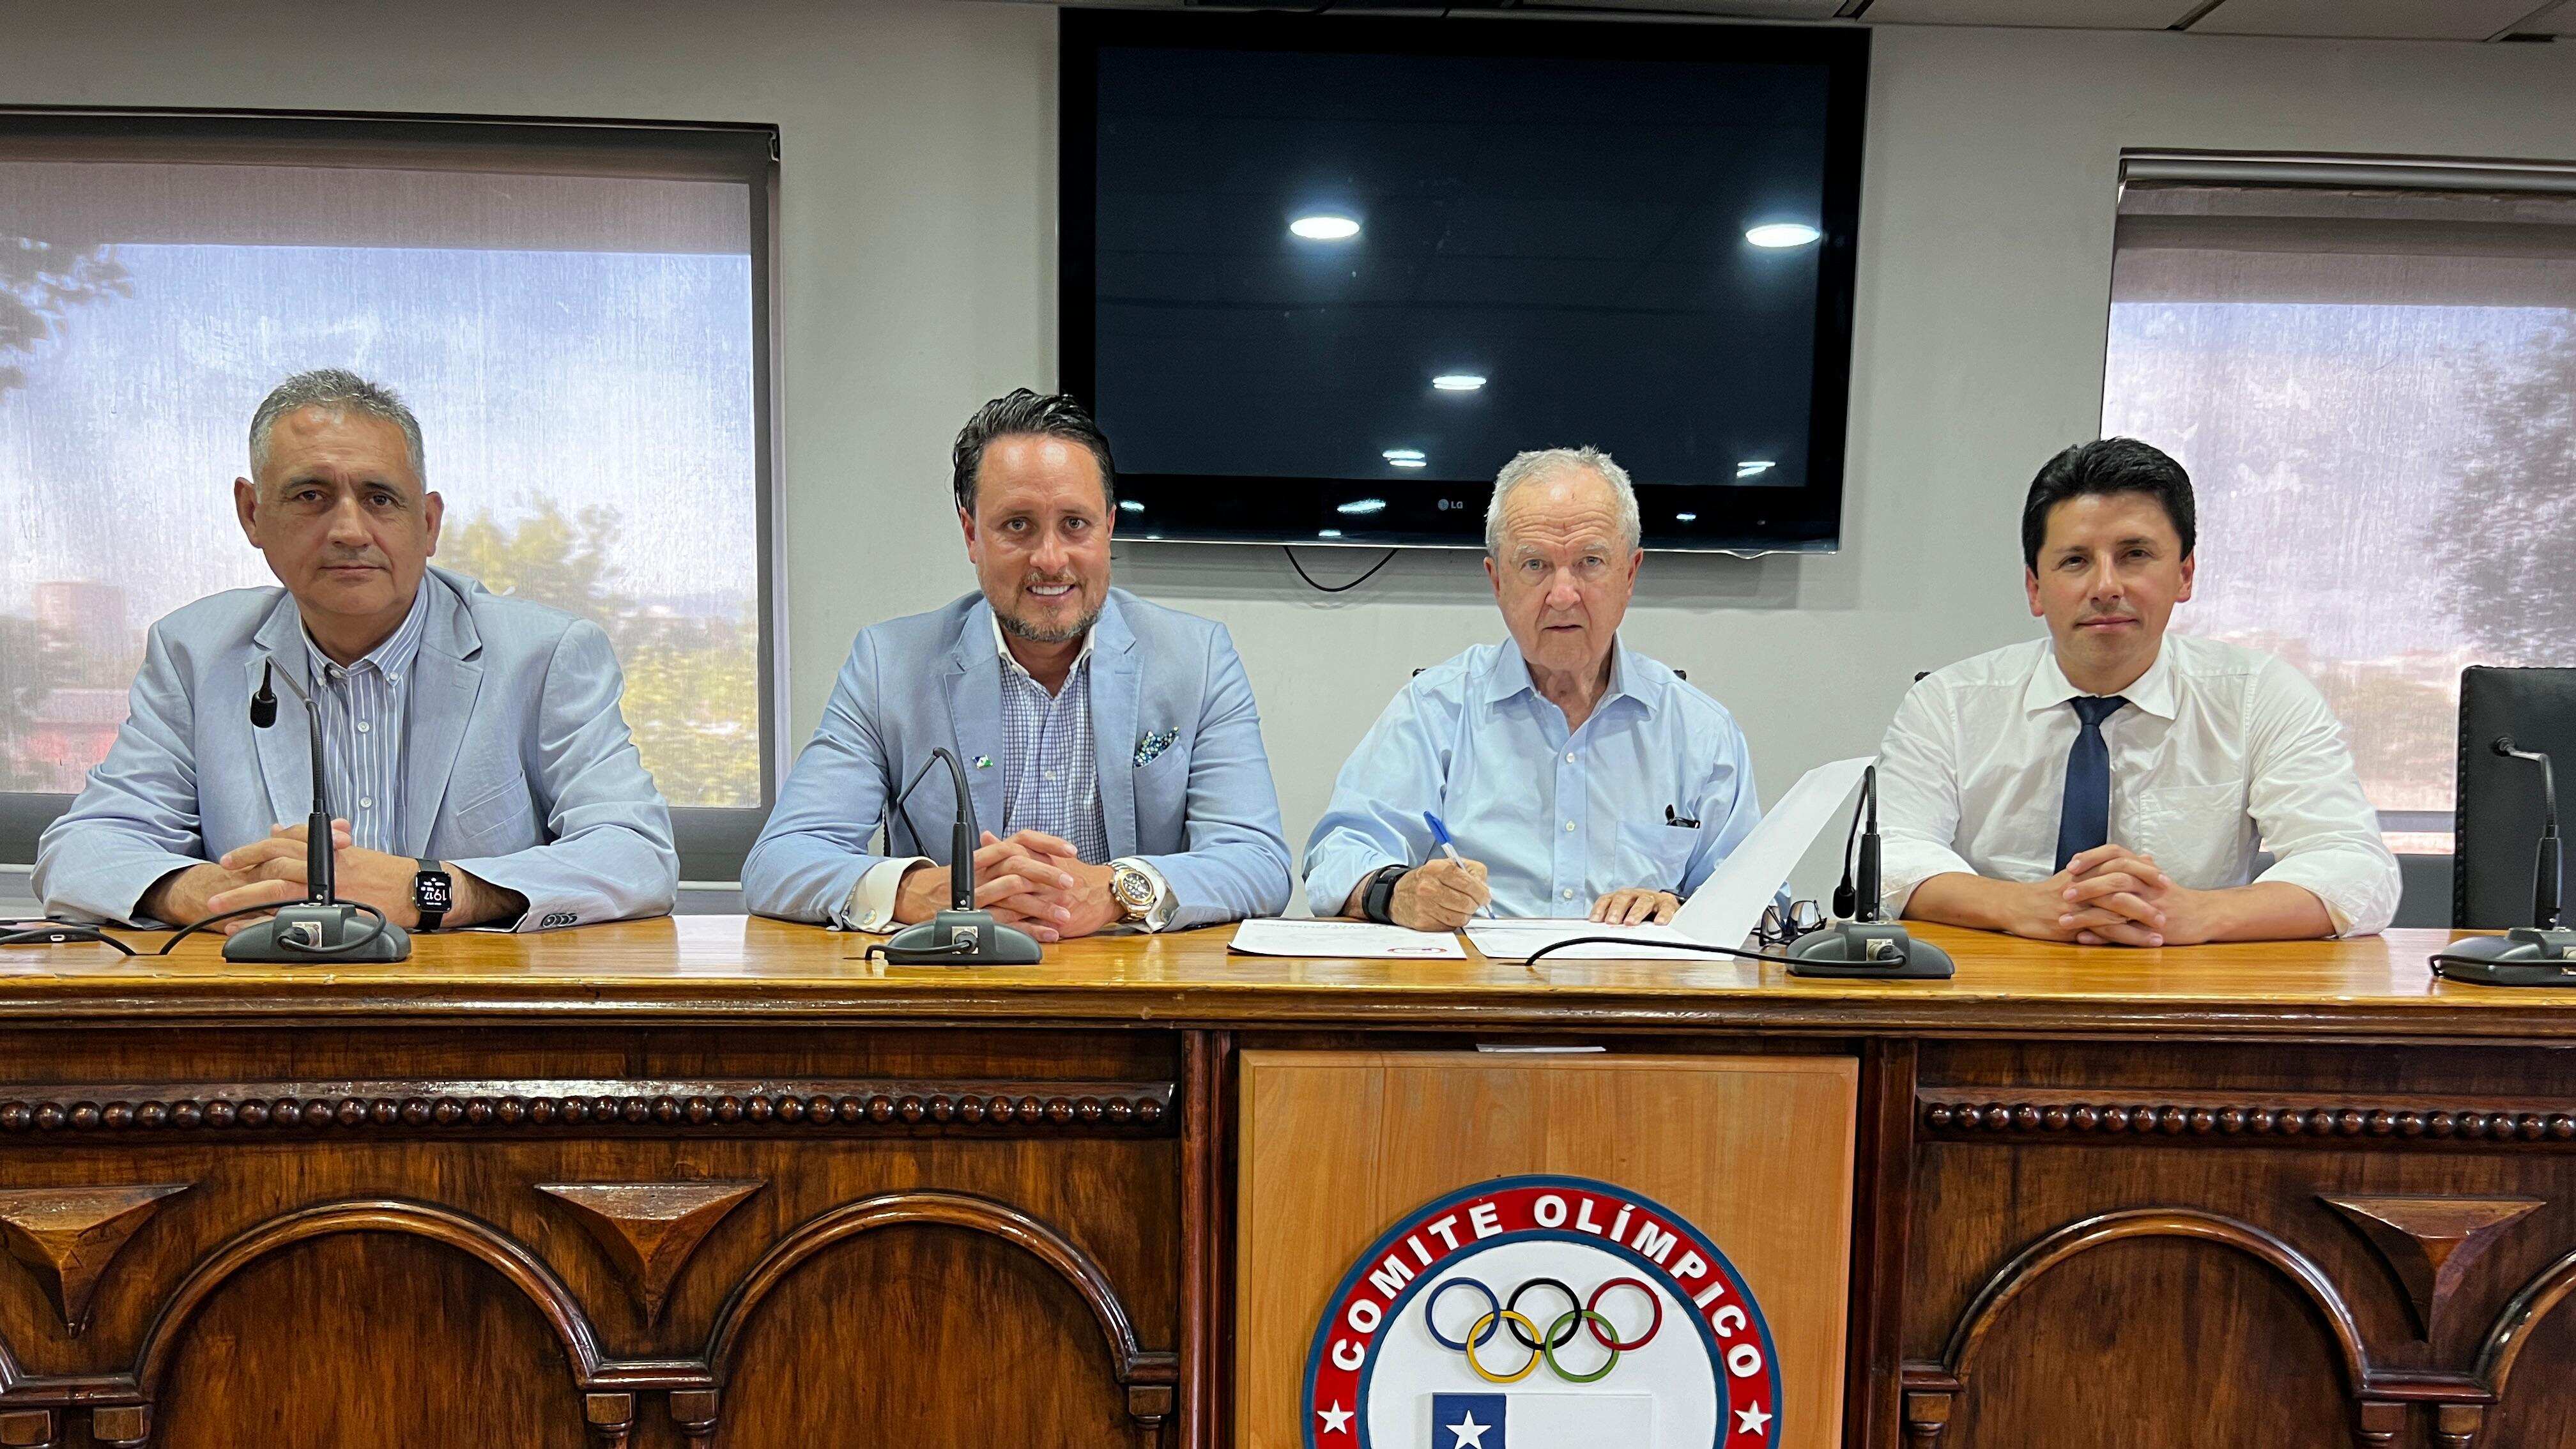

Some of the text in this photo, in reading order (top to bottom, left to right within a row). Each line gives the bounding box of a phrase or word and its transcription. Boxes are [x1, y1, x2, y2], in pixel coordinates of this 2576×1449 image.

[1451, 501, 1463, 509] LG
[1332, 1195, 1762, 1378] COMITE OLÍMPICO
